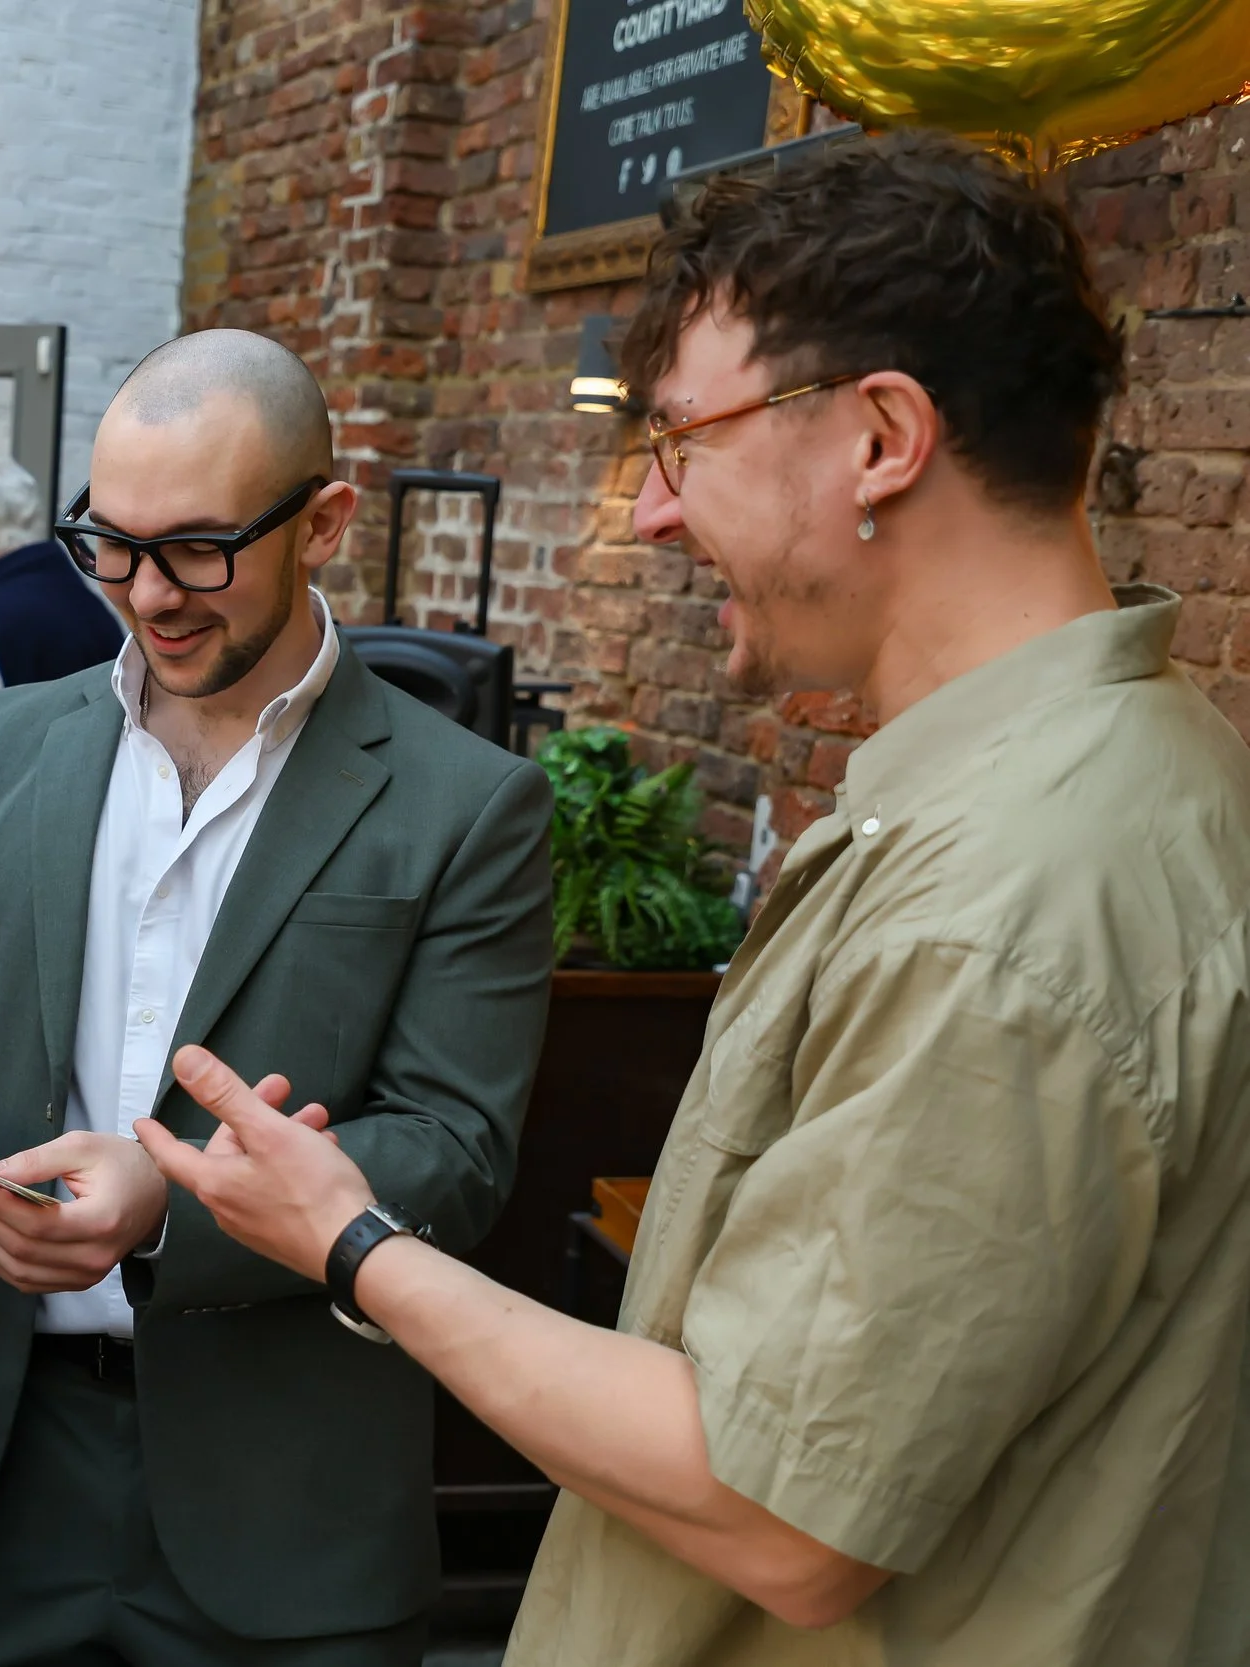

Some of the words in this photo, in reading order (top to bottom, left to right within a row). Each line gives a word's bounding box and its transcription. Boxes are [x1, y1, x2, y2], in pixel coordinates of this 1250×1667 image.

[613, 0, 728, 52] COURTYARD
[601, 64, 654, 106] AVAILABLE
[652, 58, 674, 88] FOR
[672, 40, 722, 83] PRIVATE
[719, 31, 750, 67] HIRE
